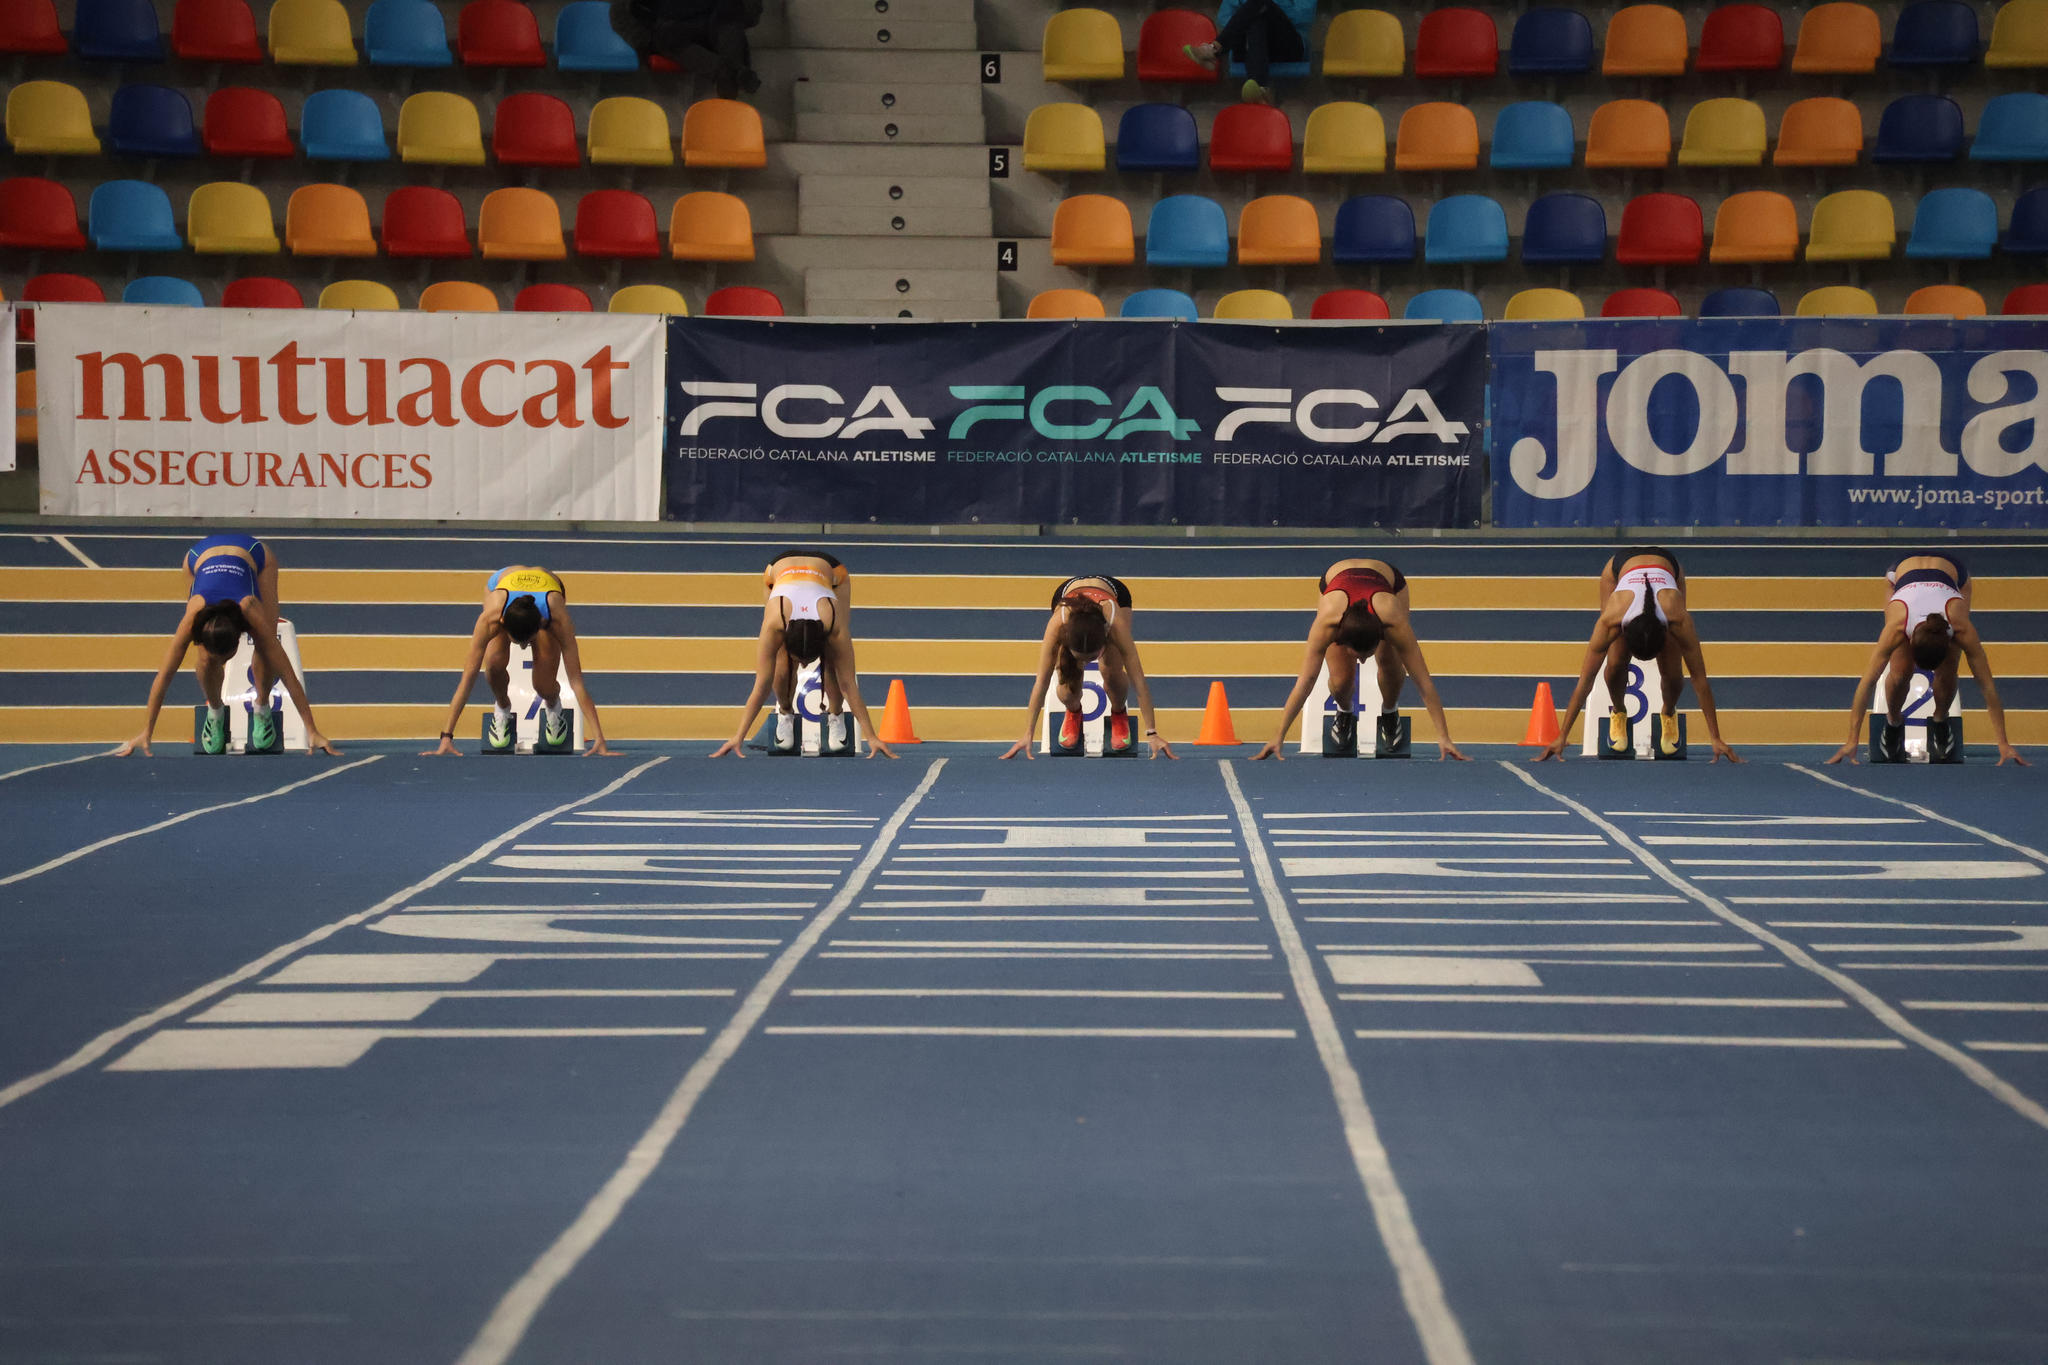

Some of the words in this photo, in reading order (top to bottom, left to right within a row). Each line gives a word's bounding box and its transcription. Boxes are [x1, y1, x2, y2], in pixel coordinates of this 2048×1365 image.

[985, 60, 997, 77] 6
[994, 154, 1005, 172] 5
[1001, 248, 1013, 265] 4
[76, 340, 630, 429] mutuacat
[680, 381, 935, 439] FCA
[947, 385, 1202, 441] FCA
[1214, 386, 1470, 443] FCA
[679, 446, 765, 460] FEDERACIÓ
[769, 449, 848, 461] CATALANA
[852, 450, 936, 462] ATLETISME
[946, 449, 1032, 462] FEDERACIÓ
[1036, 452, 1115, 463] CATALANA
[1119, 452, 1202, 464] ATLETISME
[1213, 451, 1298, 465] FEDERACIÓ
[1302, 454, 1382, 466] CATALANA
[1386, 455, 1470, 466] ATLETISME
[76, 449, 433, 489] ASSEGURANCES
[1900, 664, 1935, 727] 2
